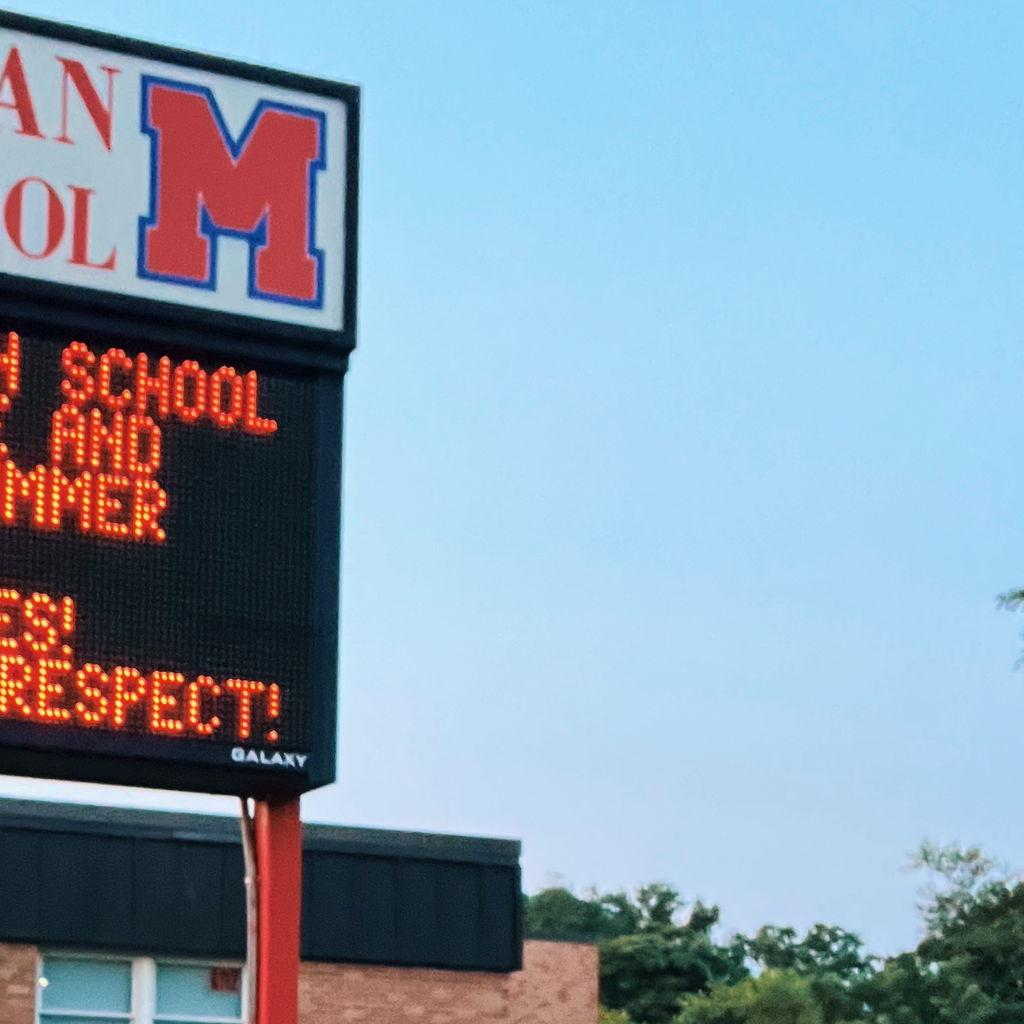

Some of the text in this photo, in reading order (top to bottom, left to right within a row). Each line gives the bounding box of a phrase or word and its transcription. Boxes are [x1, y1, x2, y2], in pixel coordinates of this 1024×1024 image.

[136, 73, 327, 310] M
[62, 341, 277, 436] SCHOOL
[51, 403, 162, 476] AND
[231, 746, 308, 768] GALAXY
